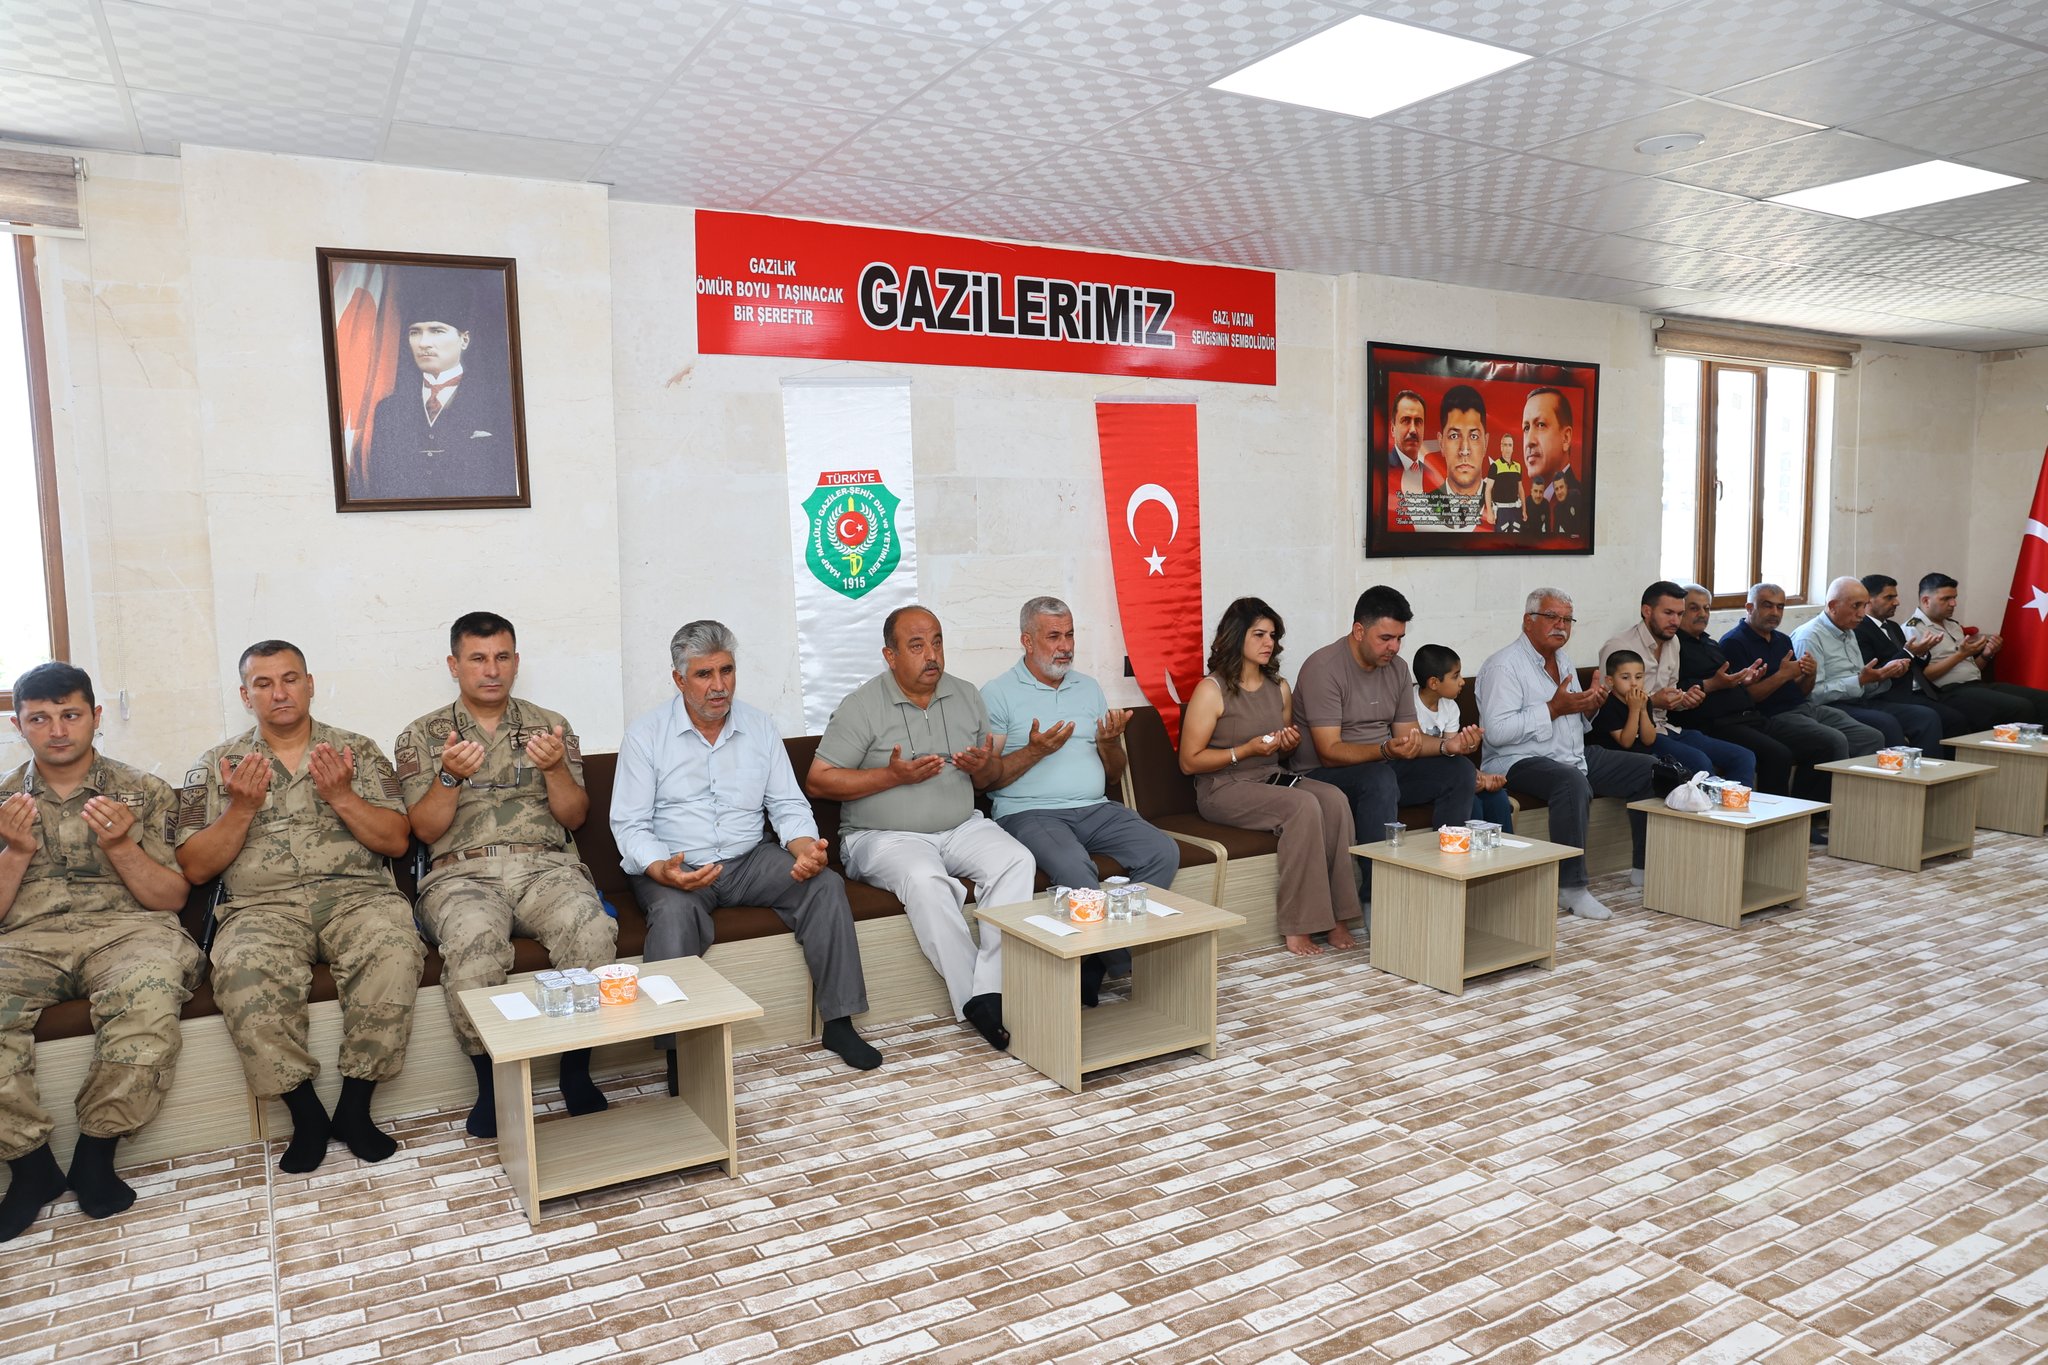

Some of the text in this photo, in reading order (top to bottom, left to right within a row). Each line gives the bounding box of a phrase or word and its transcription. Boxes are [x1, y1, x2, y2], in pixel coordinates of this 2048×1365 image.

[696, 275, 844, 304] ÖMÜR BOYU TAŞINACAK
[1231, 311, 1254, 328] VATAN
[1230, 332, 1276, 351] SEMBOLÜDÜR
[826, 471, 876, 484] TÜRKİYE
[821, 558, 841, 579] HARP
[873, 499, 886, 517] DUL
[842, 576, 866, 590] 1915
